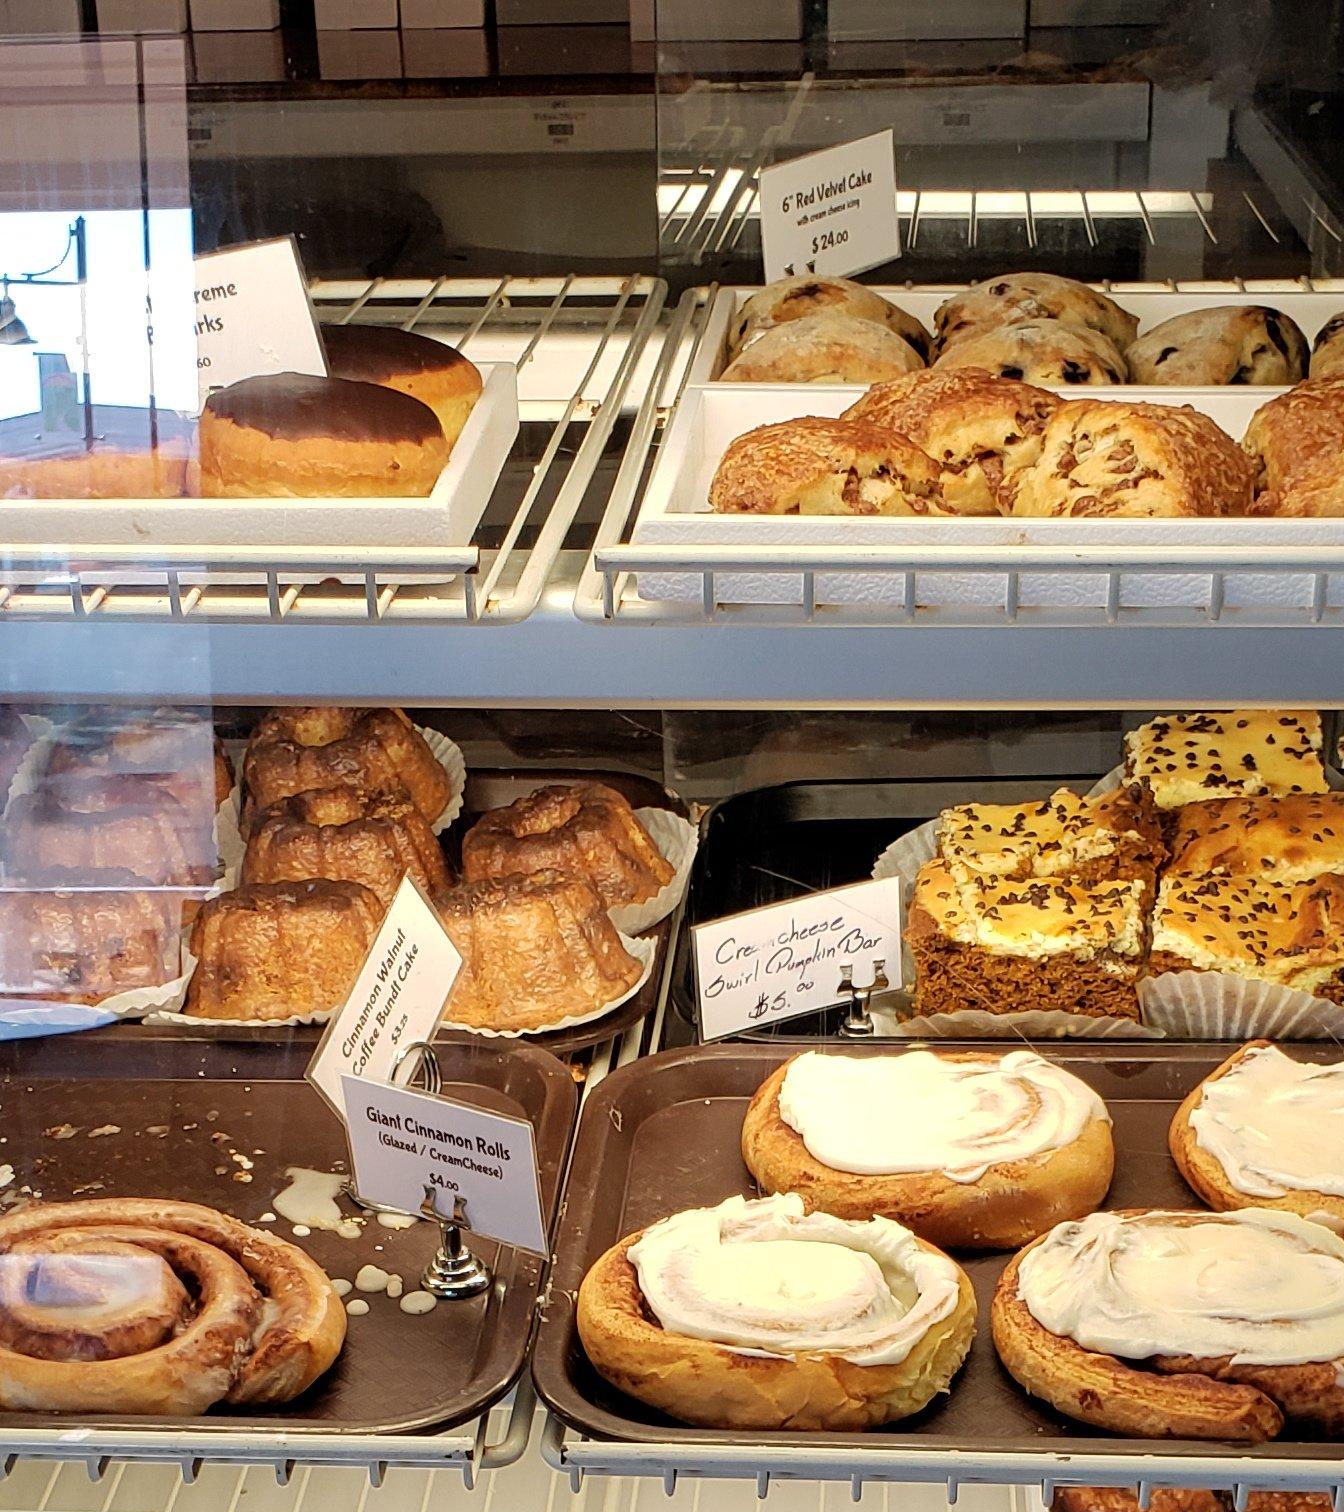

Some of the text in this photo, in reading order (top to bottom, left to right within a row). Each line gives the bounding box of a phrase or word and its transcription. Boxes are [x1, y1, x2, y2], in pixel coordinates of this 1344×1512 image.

[782, 170, 873, 213] 6" Red Velvet Cake
[193, 282, 238, 304] reme
[777, 916, 845, 945] cheese
[704, 928, 883, 999] Swirl Pumpkin Bar
[341, 928, 408, 1060] Cinnamon Walnut
[352, 942, 420, 1078] Coffee Bundt Cake
[365, 1106, 512, 1161] Giant Cinnamon Rolls
[377, 1131, 418, 1156] (Glazed
[429, 1147, 504, 1180] CreamCheese)
[429, 1172, 460, 1193] $4.00
